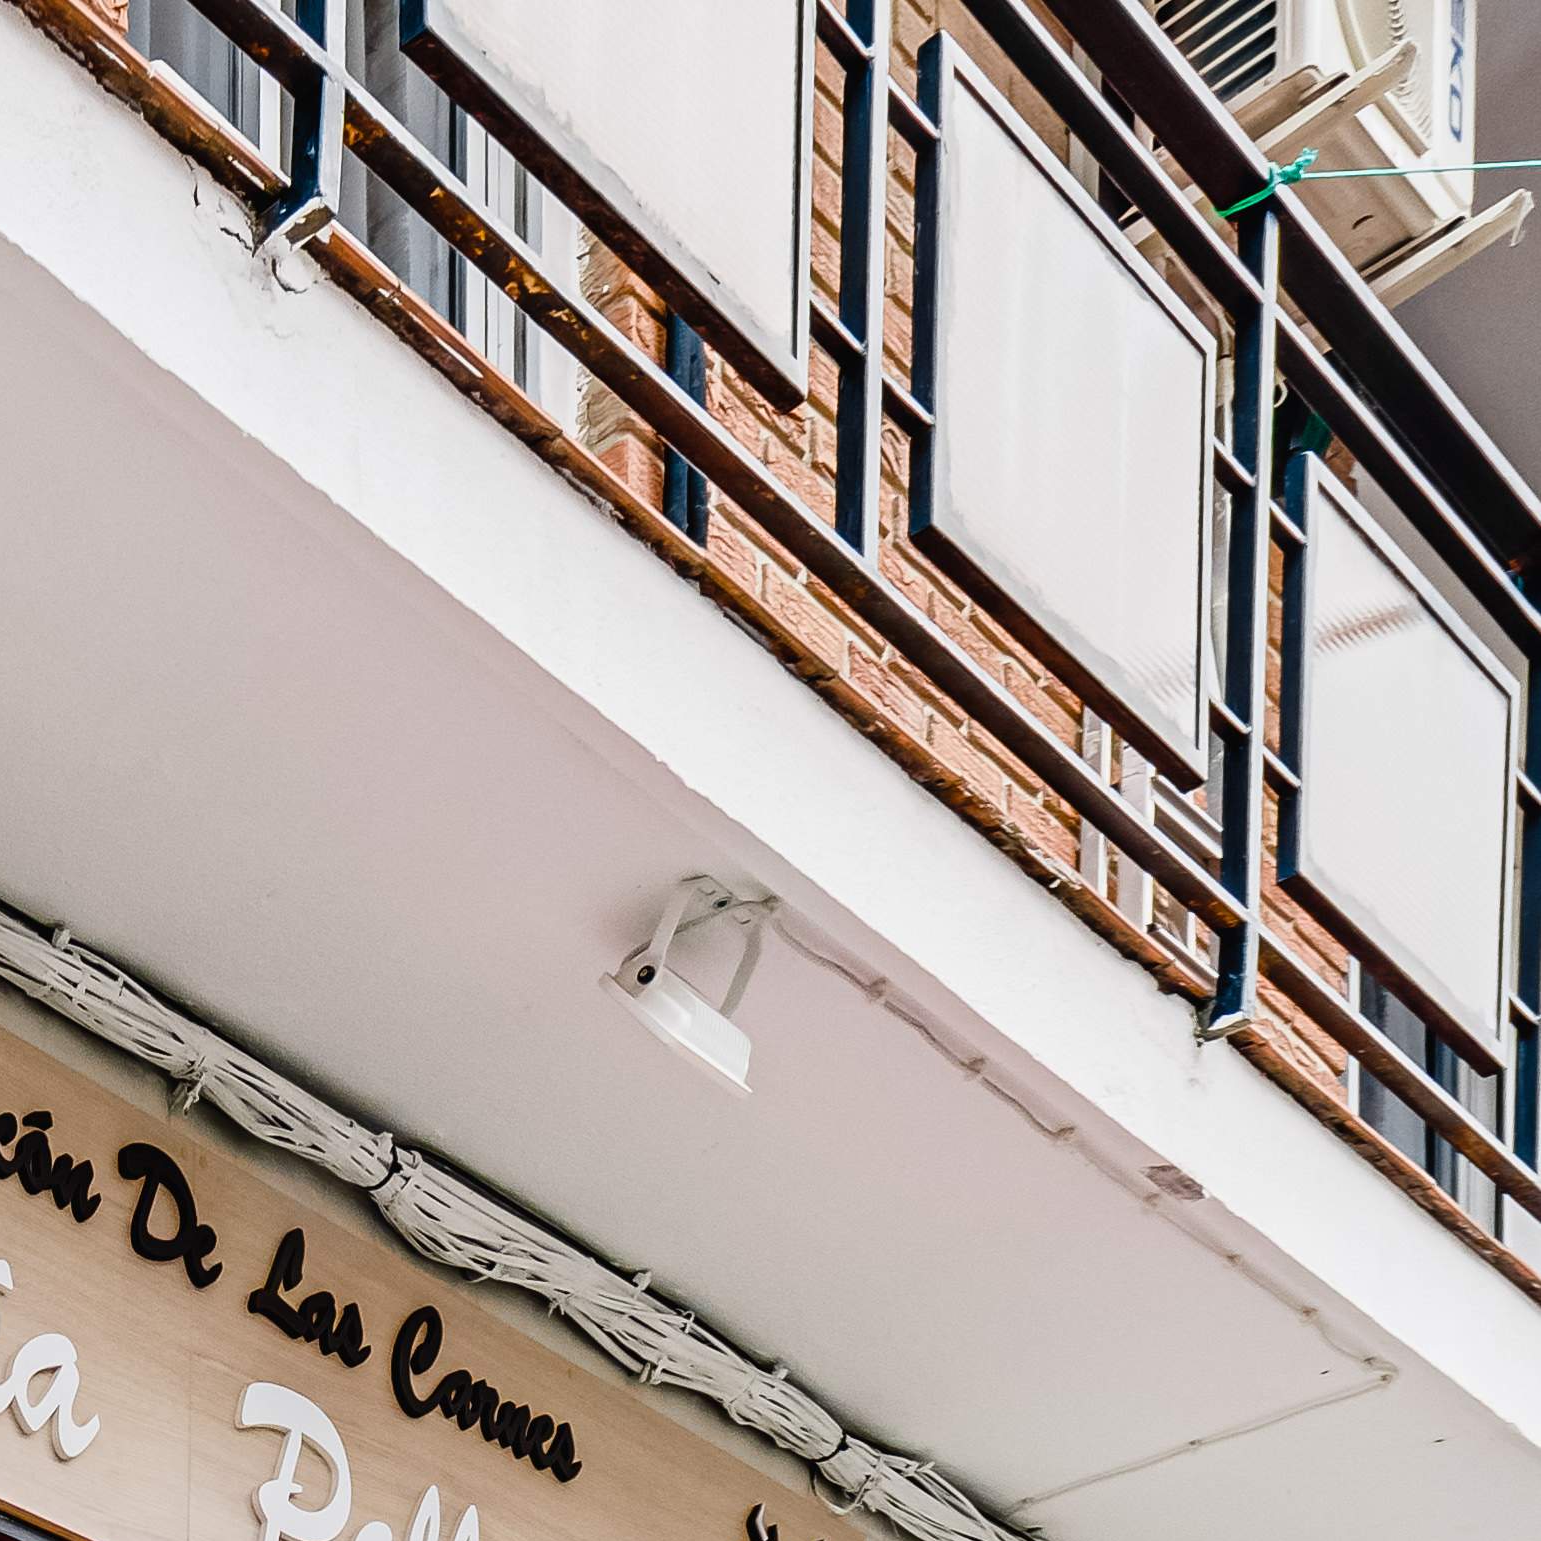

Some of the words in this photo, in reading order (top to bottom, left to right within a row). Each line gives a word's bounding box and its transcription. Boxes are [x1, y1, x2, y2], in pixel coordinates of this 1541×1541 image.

[119, 1142, 224, 1289] De
[247, 1228, 370, 1370] Las
[390, 1305, 582, 1484] Carnes
